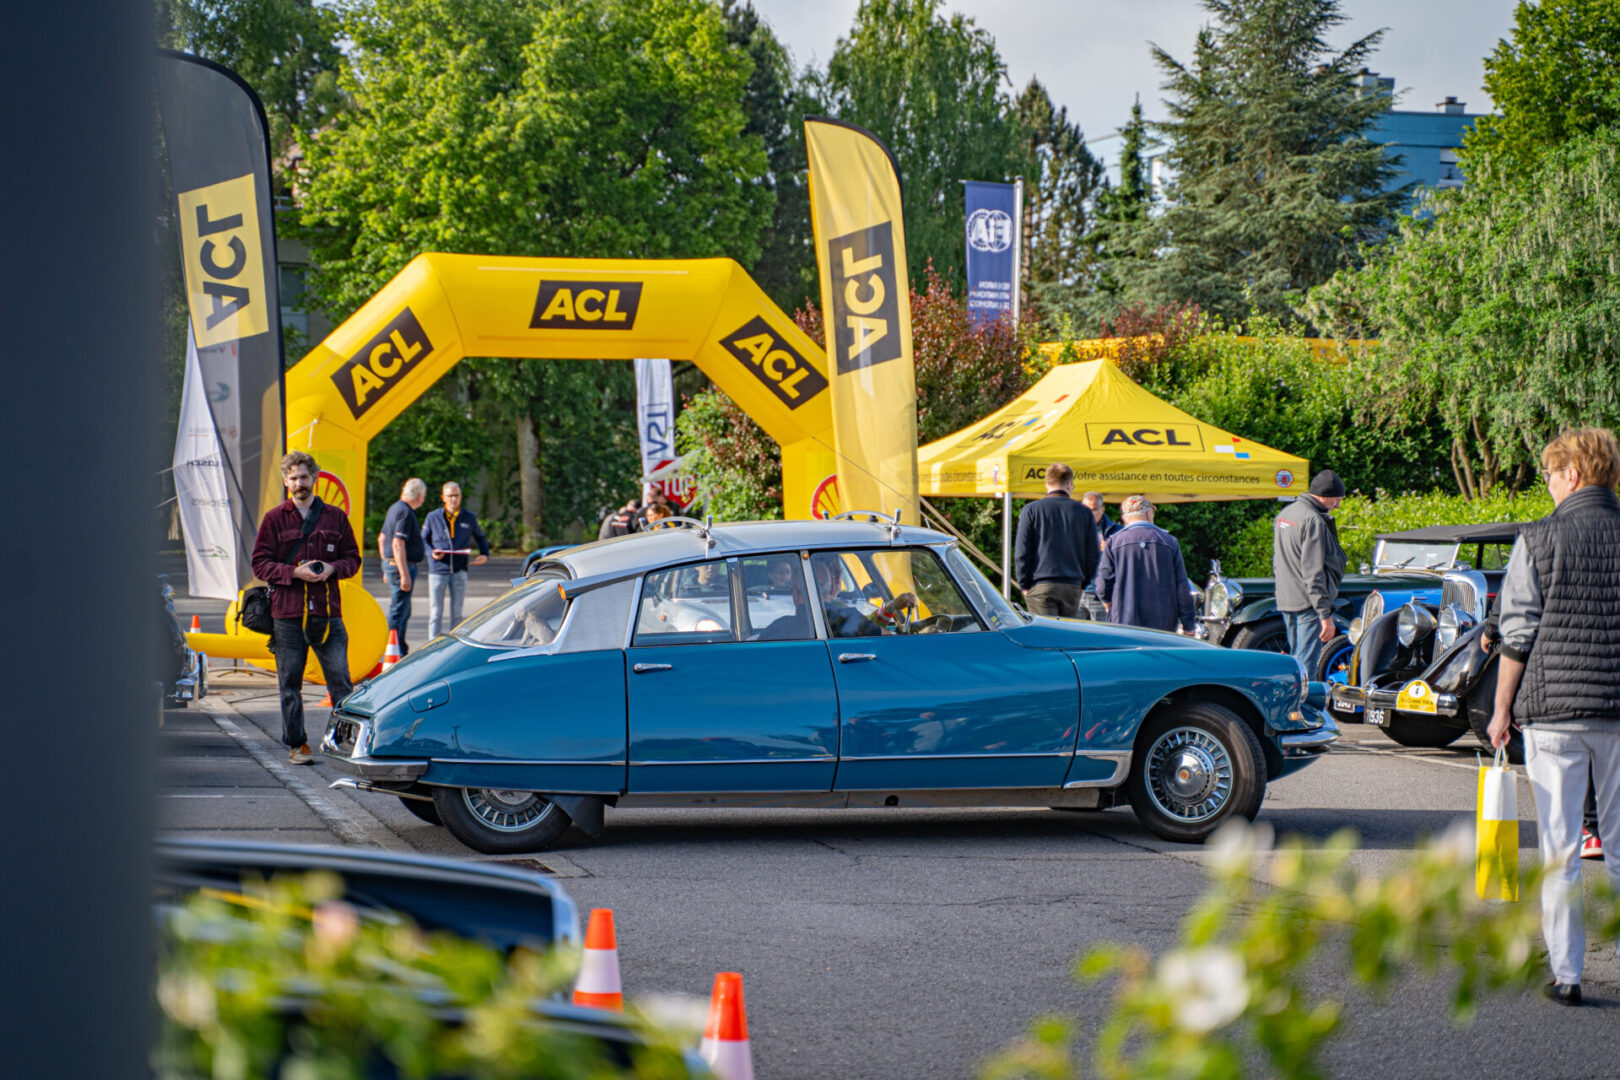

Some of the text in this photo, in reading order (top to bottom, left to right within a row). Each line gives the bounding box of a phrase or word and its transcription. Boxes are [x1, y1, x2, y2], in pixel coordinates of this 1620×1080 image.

[540, 288, 627, 322] ACL
[350, 328, 423, 407] ACL
[732, 332, 810, 400] ACL
[1101, 428, 1191, 446] ACL
[1025, 467, 1047, 480] AC
[1098, 471, 1147, 481] assistance
[1149, 473, 1162, 481] en
[1164, 472, 1194, 483] toutes
[1196, 472, 1260, 485] circonstances
